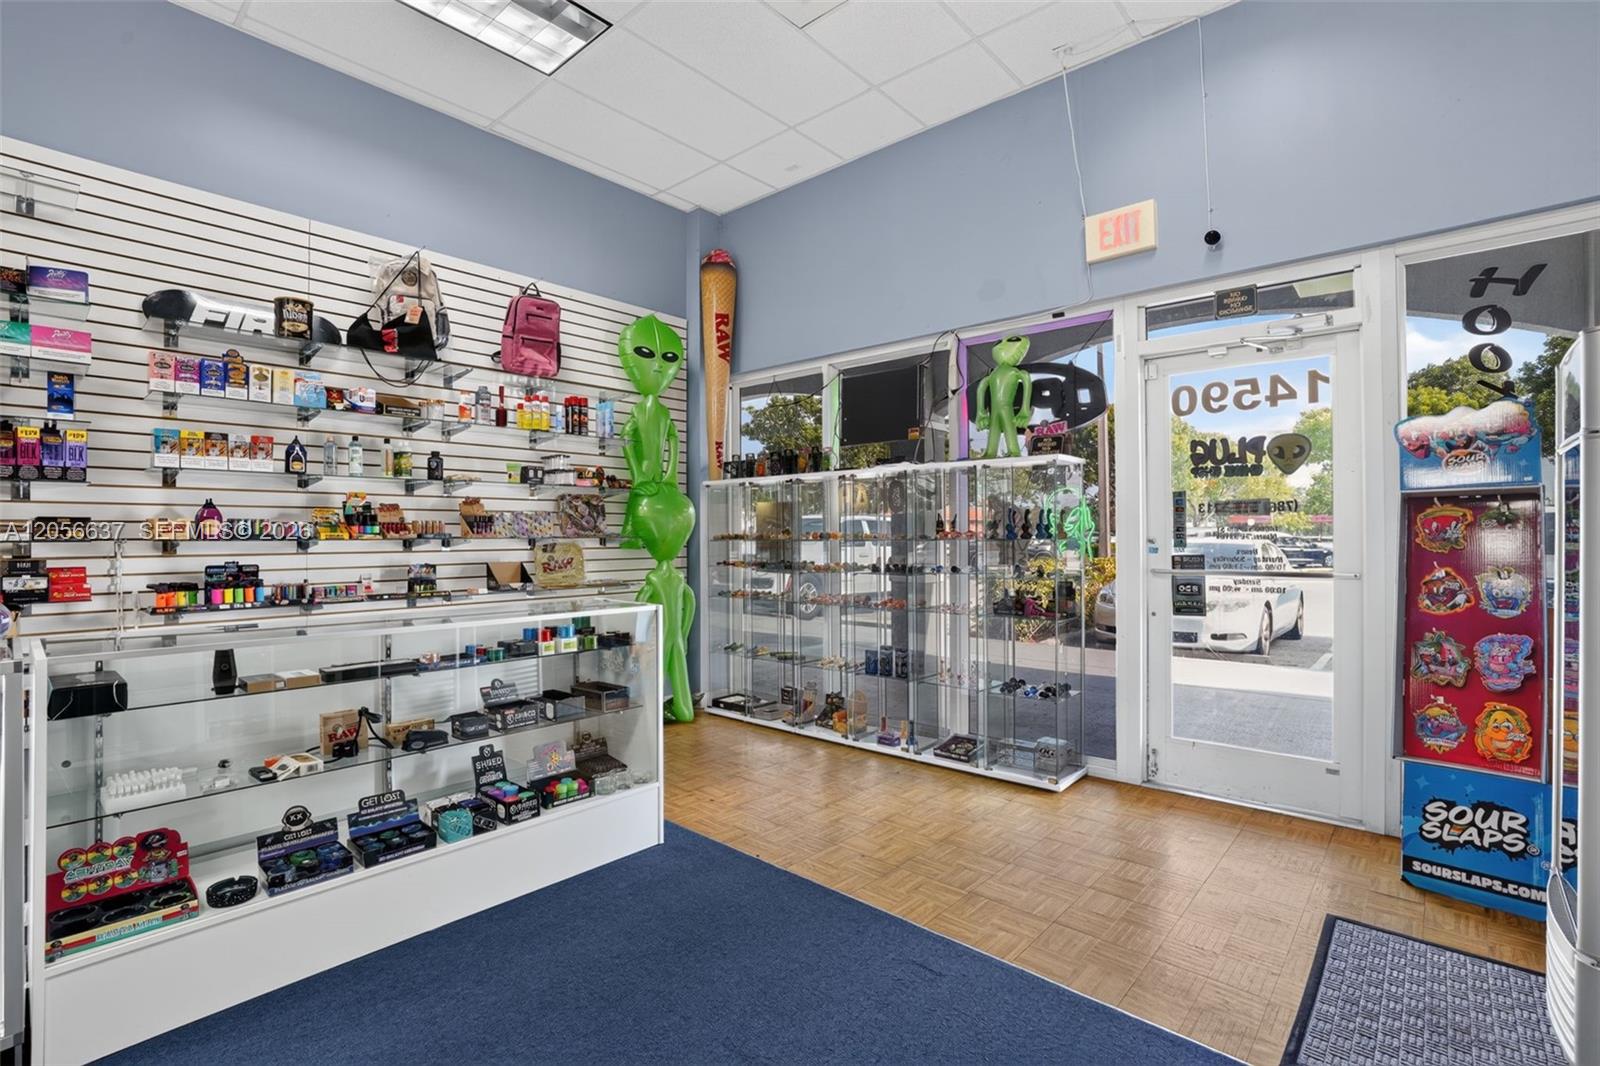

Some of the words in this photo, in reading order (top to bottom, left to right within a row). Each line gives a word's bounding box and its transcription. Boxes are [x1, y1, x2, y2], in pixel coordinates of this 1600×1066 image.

[1099, 210, 1142, 251] EXIT
[715, 313, 731, 364] RAW
[1034, 421, 1067, 437] RAW
[327, 724, 358, 743] RAW
[475, 757, 503, 769] SHRED
[361, 797, 379, 808] GET
[380, 791, 401, 804] LOST
[1424, 800, 1528, 834] SOUR
[1420, 820, 1527, 854] SLAPS
[1411, 860, 1547, 903] SOURSLAPS.COM
